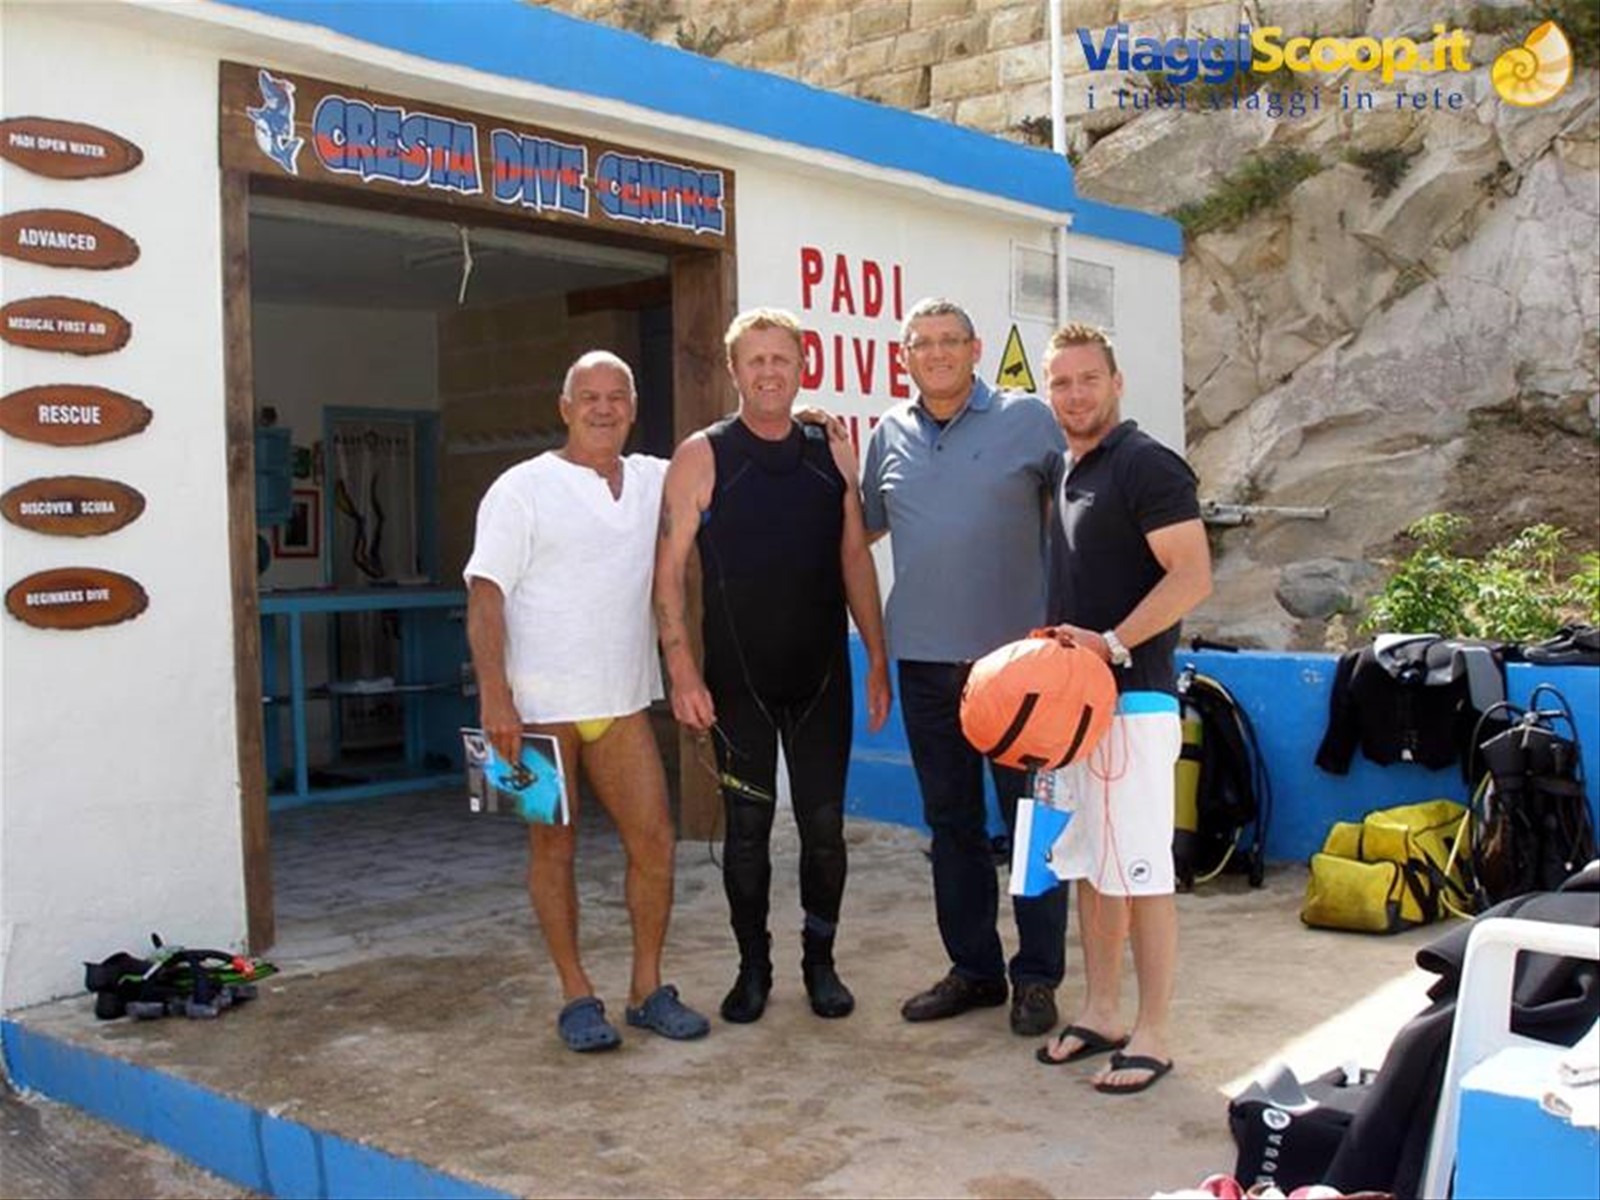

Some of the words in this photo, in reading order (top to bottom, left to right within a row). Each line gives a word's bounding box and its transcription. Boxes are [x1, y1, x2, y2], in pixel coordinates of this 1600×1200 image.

[9, 133, 35, 148] PADI
[37, 137, 67, 152] OPEN
[69, 141, 106, 158] WATER
[312, 94, 483, 193] CRESTA
[491, 128, 591, 218] DIVE
[595, 152, 725, 235] CENTRE
[18, 228, 97, 251] ADVANCED
[800, 247, 904, 321] PADI
[8, 316, 56, 332] MEDICAL
[57, 319, 86, 334] FIRST
[87, 321, 106, 336] AID
[800, 329, 910, 399] DIVE
[38, 404, 101, 424] RESCUE
[20, 500, 74, 515] DISCOVER
[80, 500, 116, 514] SCUBA
[26, 589, 84, 606] BEGINNERS
[85, 588, 110, 601] DIVE
